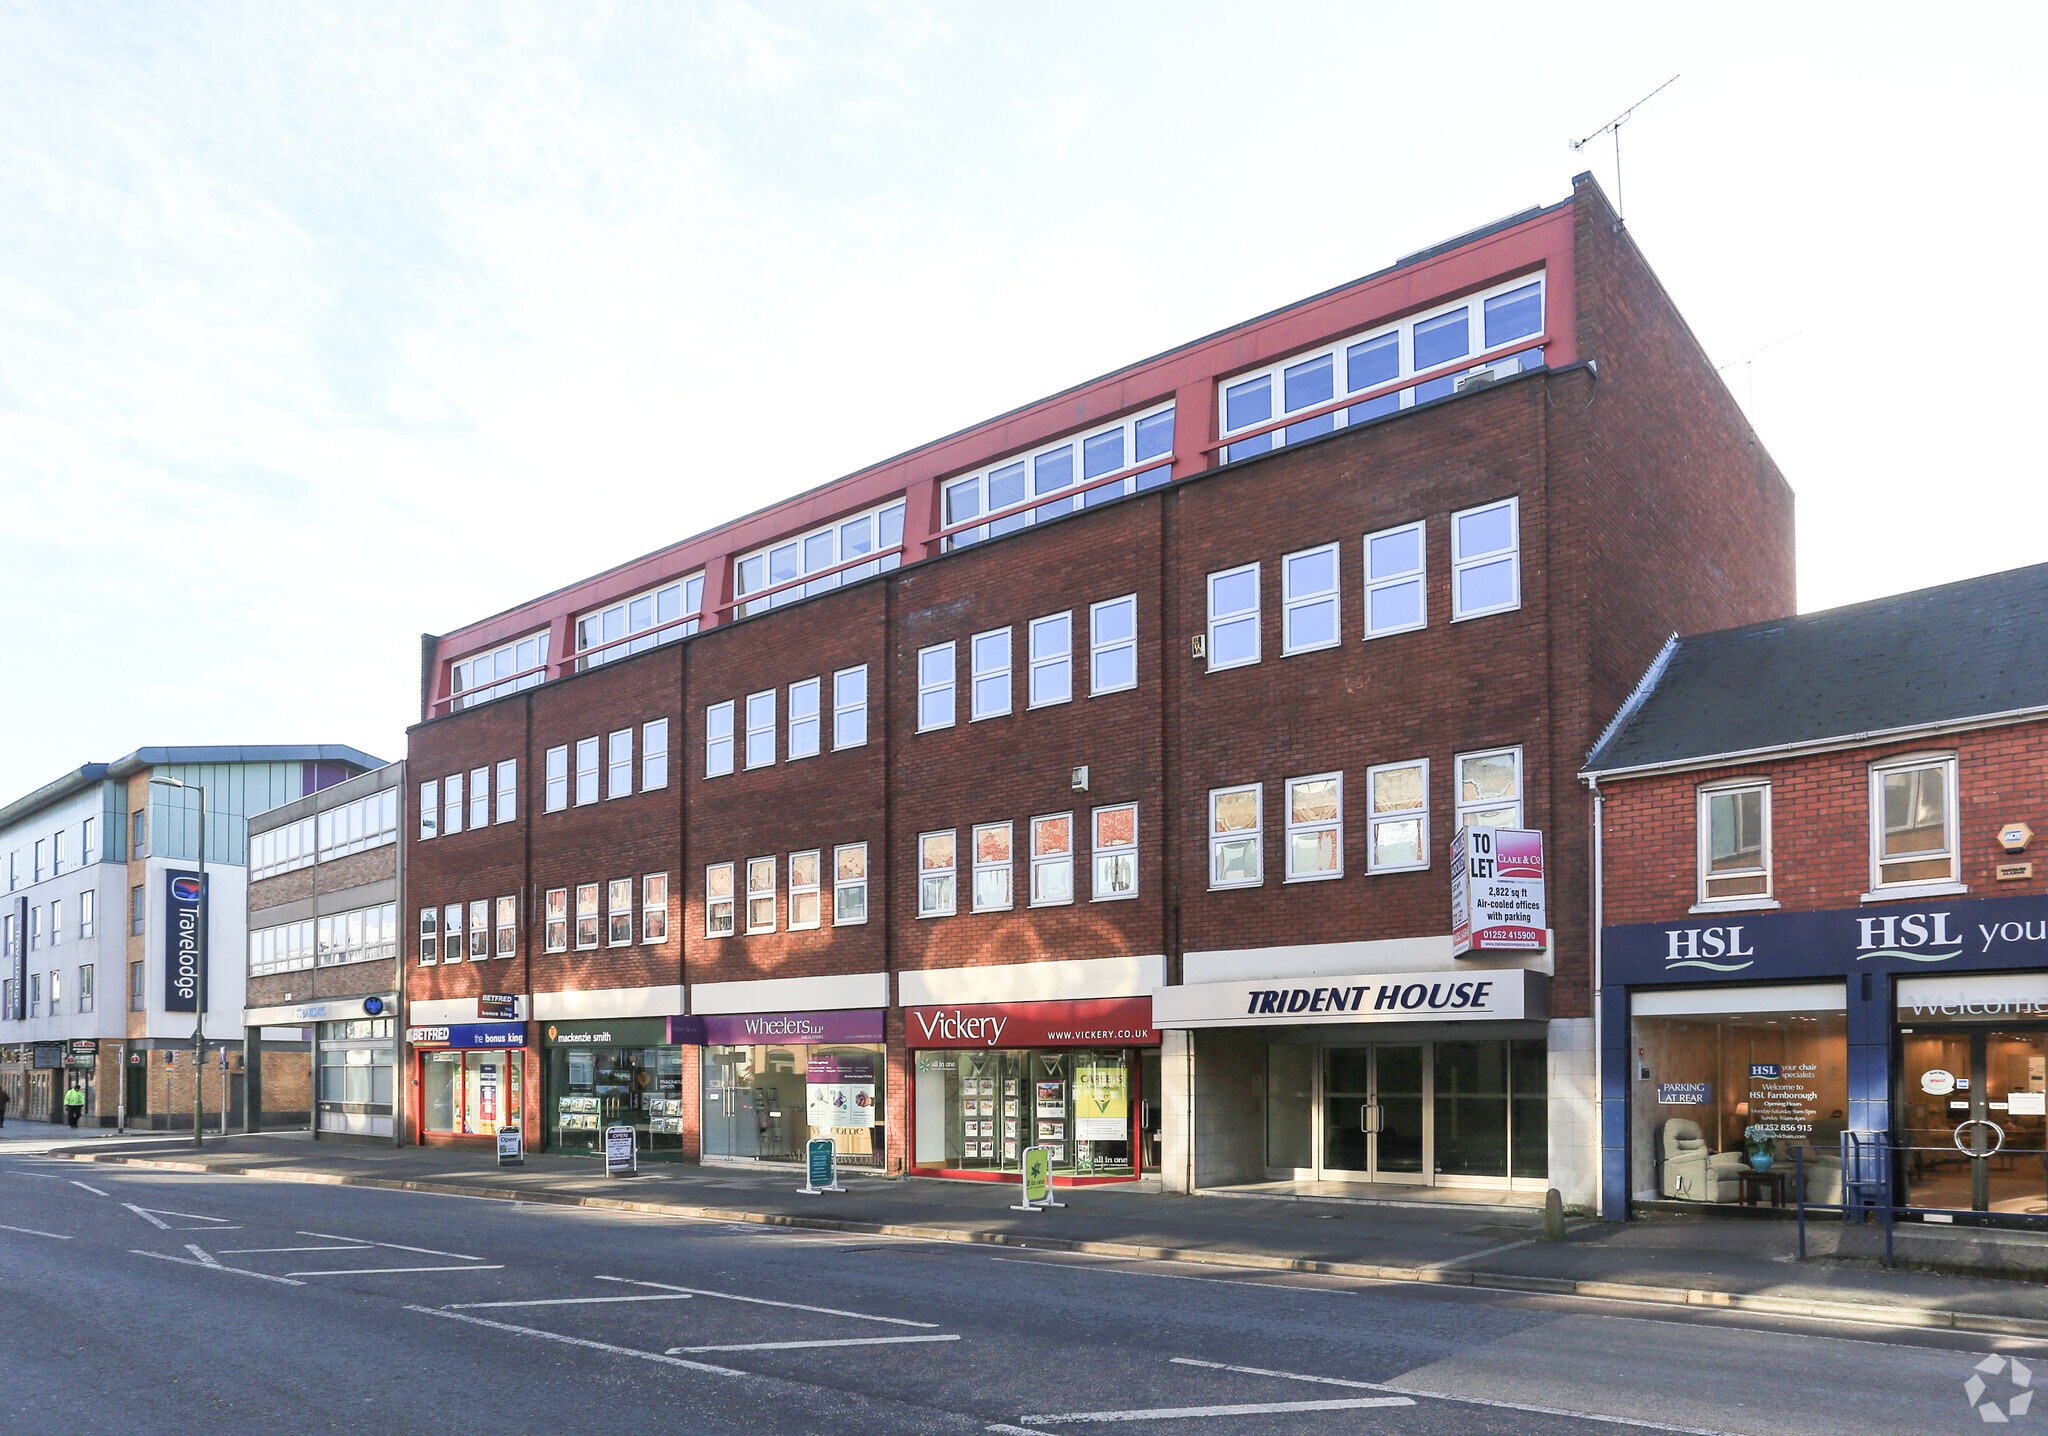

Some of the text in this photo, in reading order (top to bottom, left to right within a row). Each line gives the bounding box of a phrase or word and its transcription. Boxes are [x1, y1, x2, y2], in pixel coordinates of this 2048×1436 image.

[1472, 833, 1491, 854] TO
[1497, 854, 1522, 864] CLARE
[1523, 855, 1529, 864] &
[1471, 858, 1494, 879] LET
[1488, 886, 1528, 899] 2,822 sq ft
[1477, 899, 1540, 910] Air-cooled offices
[1487, 912, 1531, 924] with parking
[1483, 930, 1536, 940] 01252 415900
[1857, 912, 2046, 953] HSL you
[1665, 926, 1754, 960] HSL
[174, 905, 199, 999] Travelodge
[1247, 981, 1493, 1014] TRIDENT HOUSE
[1909, 990, 2048, 1016] Welcome
[303, 1006, 327, 1018] BARCLAYS
[745, 1016, 810, 1035] Wheelers
[914, 1010, 1008, 1046] Vickery
[412, 1027, 449, 1041] BETFRED
[474, 1032, 523, 1044] the bonus king
[558, 1032, 611, 1043] mackenzie smith
[1047, 1029, 1149, 1040] WWW.VICKERY.CO.UK
[1752, 1065, 1777, 1075] HSL
[1798, 1063, 1817, 1071] chair
[1080, 1074, 1123, 1084] CAREERS
[1782, 1071, 1816, 1080] specialists
[1664, 1083, 1705, 1092] PARKING
[1762, 1083, 1795, 1091] Welcome
[1665, 1094, 1703, 1102] AT REAR
[1767, 1091, 1818, 1101] Farnborough
[1754, 1123, 1779, 1131] 01252
[1797, 1124, 1813, 1132] 915
[1094, 1156, 1104, 1164] all
[1105, 1156, 1112, 1164] in
